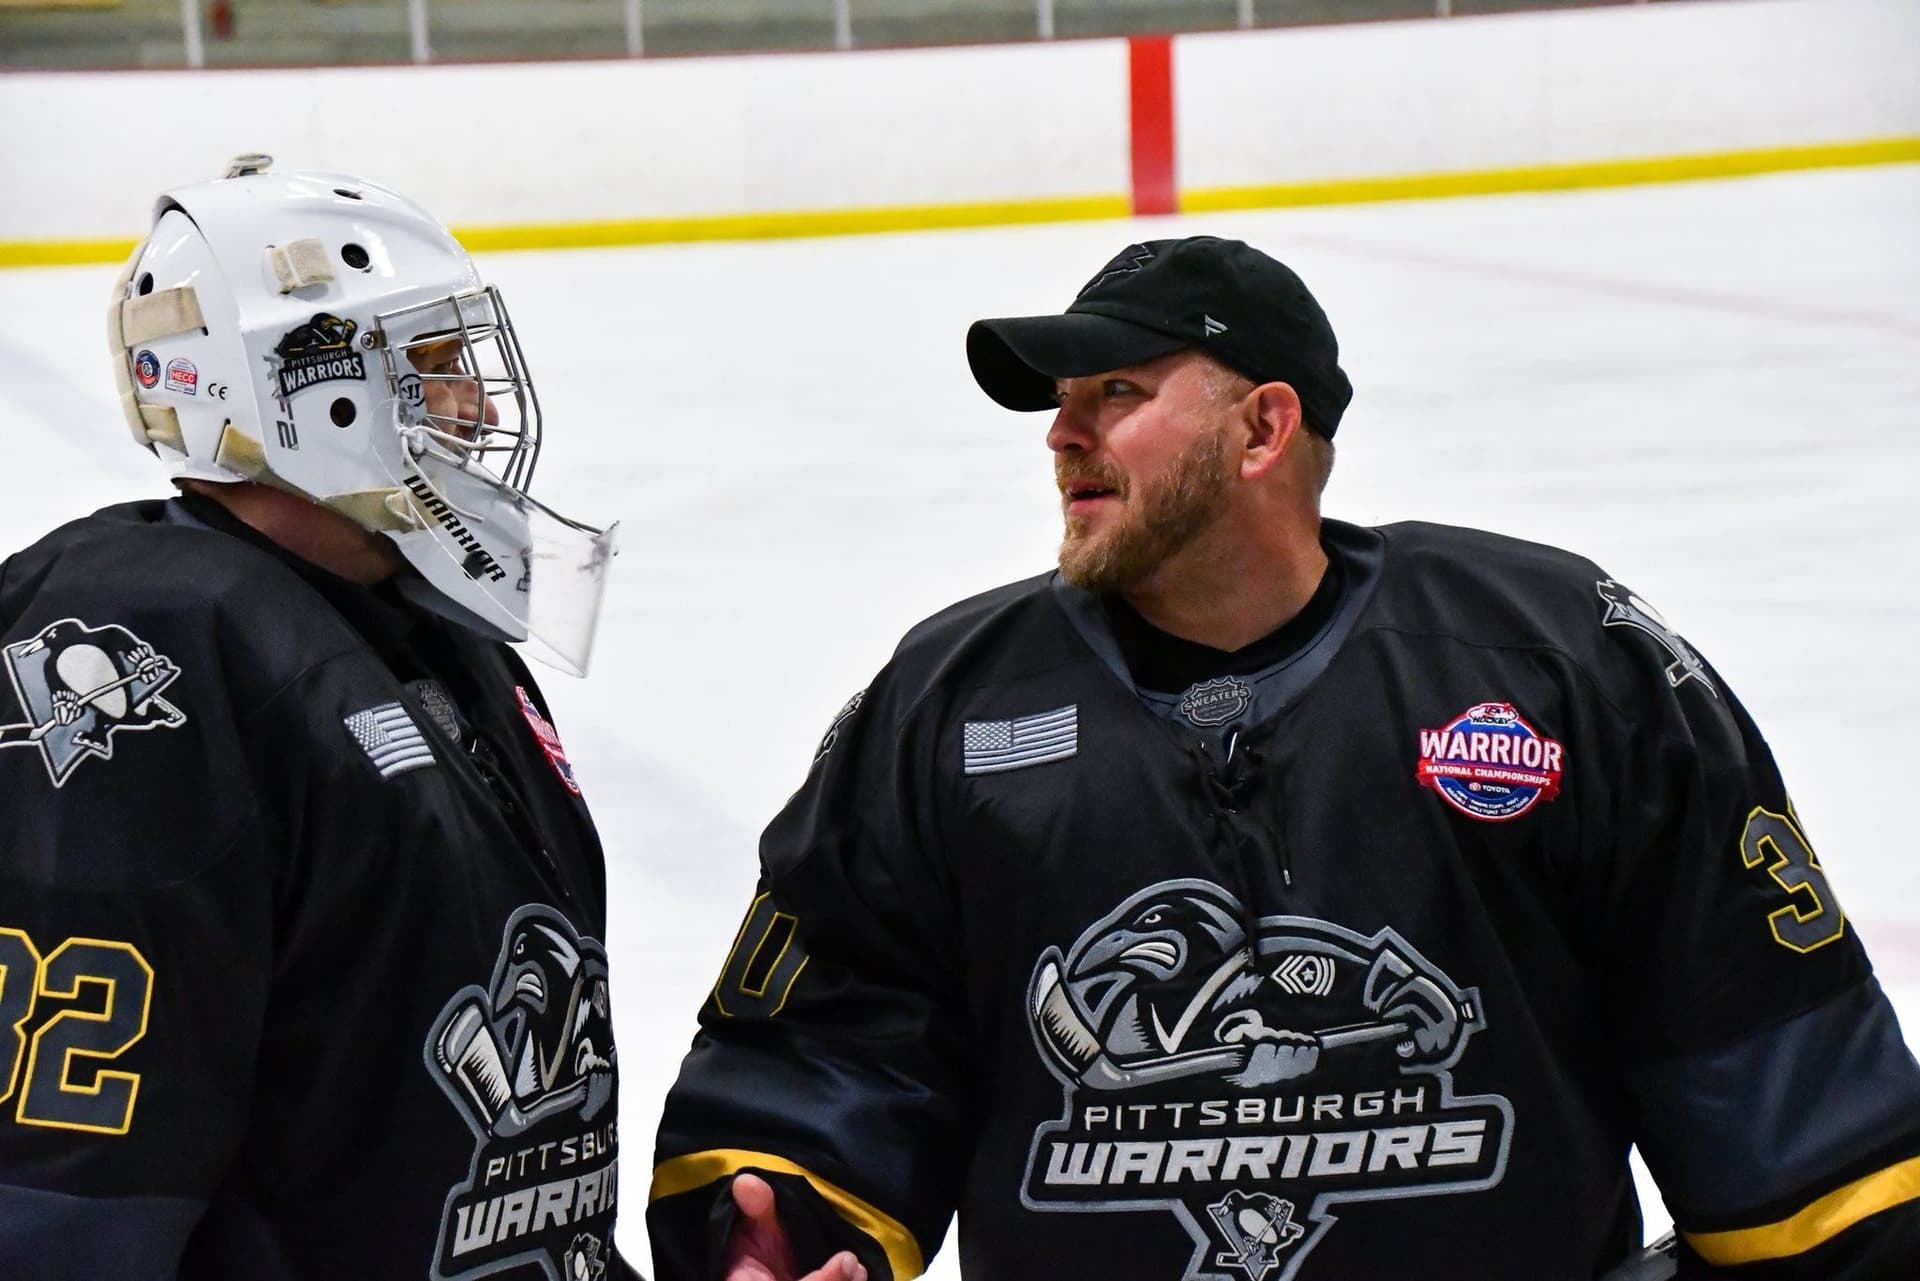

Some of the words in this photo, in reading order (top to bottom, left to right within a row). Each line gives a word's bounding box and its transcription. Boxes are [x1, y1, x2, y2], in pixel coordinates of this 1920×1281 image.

[282, 357, 362, 393] WARRIORS
[290, 350, 347, 368] PITTSBURGH
[403, 475, 506, 582] WARRIOR
[1184, 688, 1248, 711] SWEATERS
[1420, 731, 1562, 771] WARRIOR
[1426, 764, 1472, 776] NATIONAL
[1474, 768, 1552, 786] CHAMPIONSHIPS
[1483, 785, 1511, 794] TOYOTA
[1085, 1087, 1425, 1131] PITTSBURGH
[485, 1122, 618, 1187] PITTSBUR
[1045, 1120, 1486, 1185] WARRIORS
